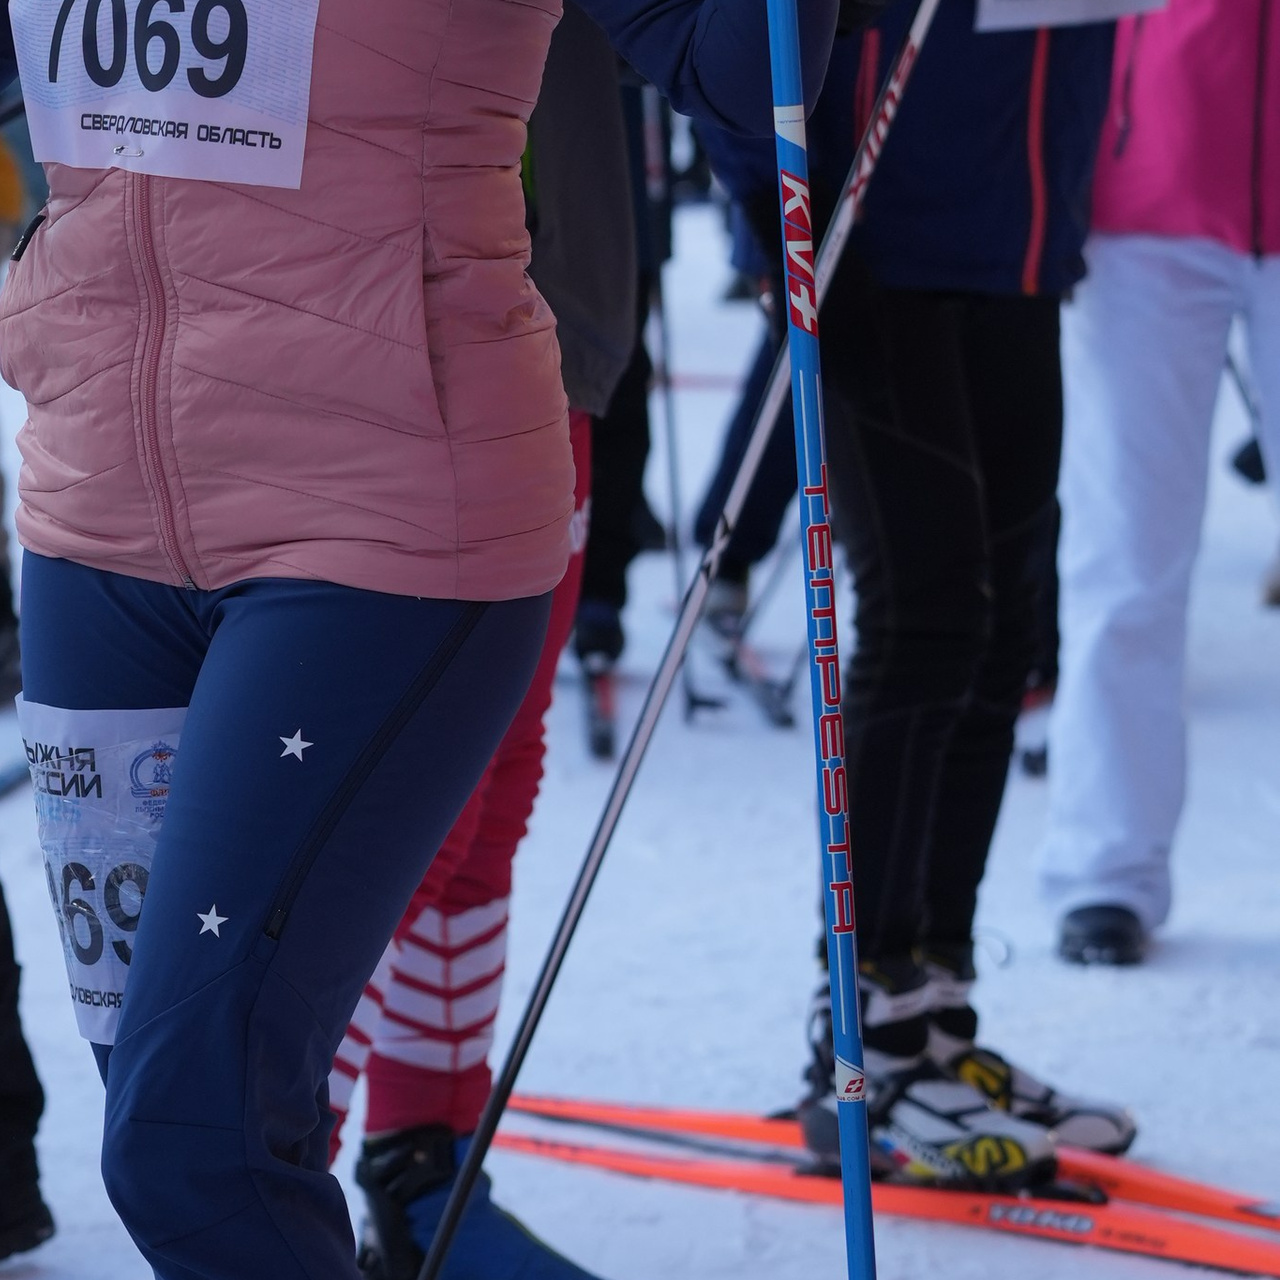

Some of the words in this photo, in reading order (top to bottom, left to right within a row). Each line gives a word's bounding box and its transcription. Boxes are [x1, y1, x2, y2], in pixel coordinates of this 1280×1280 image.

[80, 113, 189, 139] СВЕРДЛОВСКАЯ
[197, 124, 282, 150] ОБЛАСТЬ
[22, 737, 96, 772] ЫЖНЯ
[35, 770, 102, 799] ССИИ
[46, 861, 150, 967] 69
